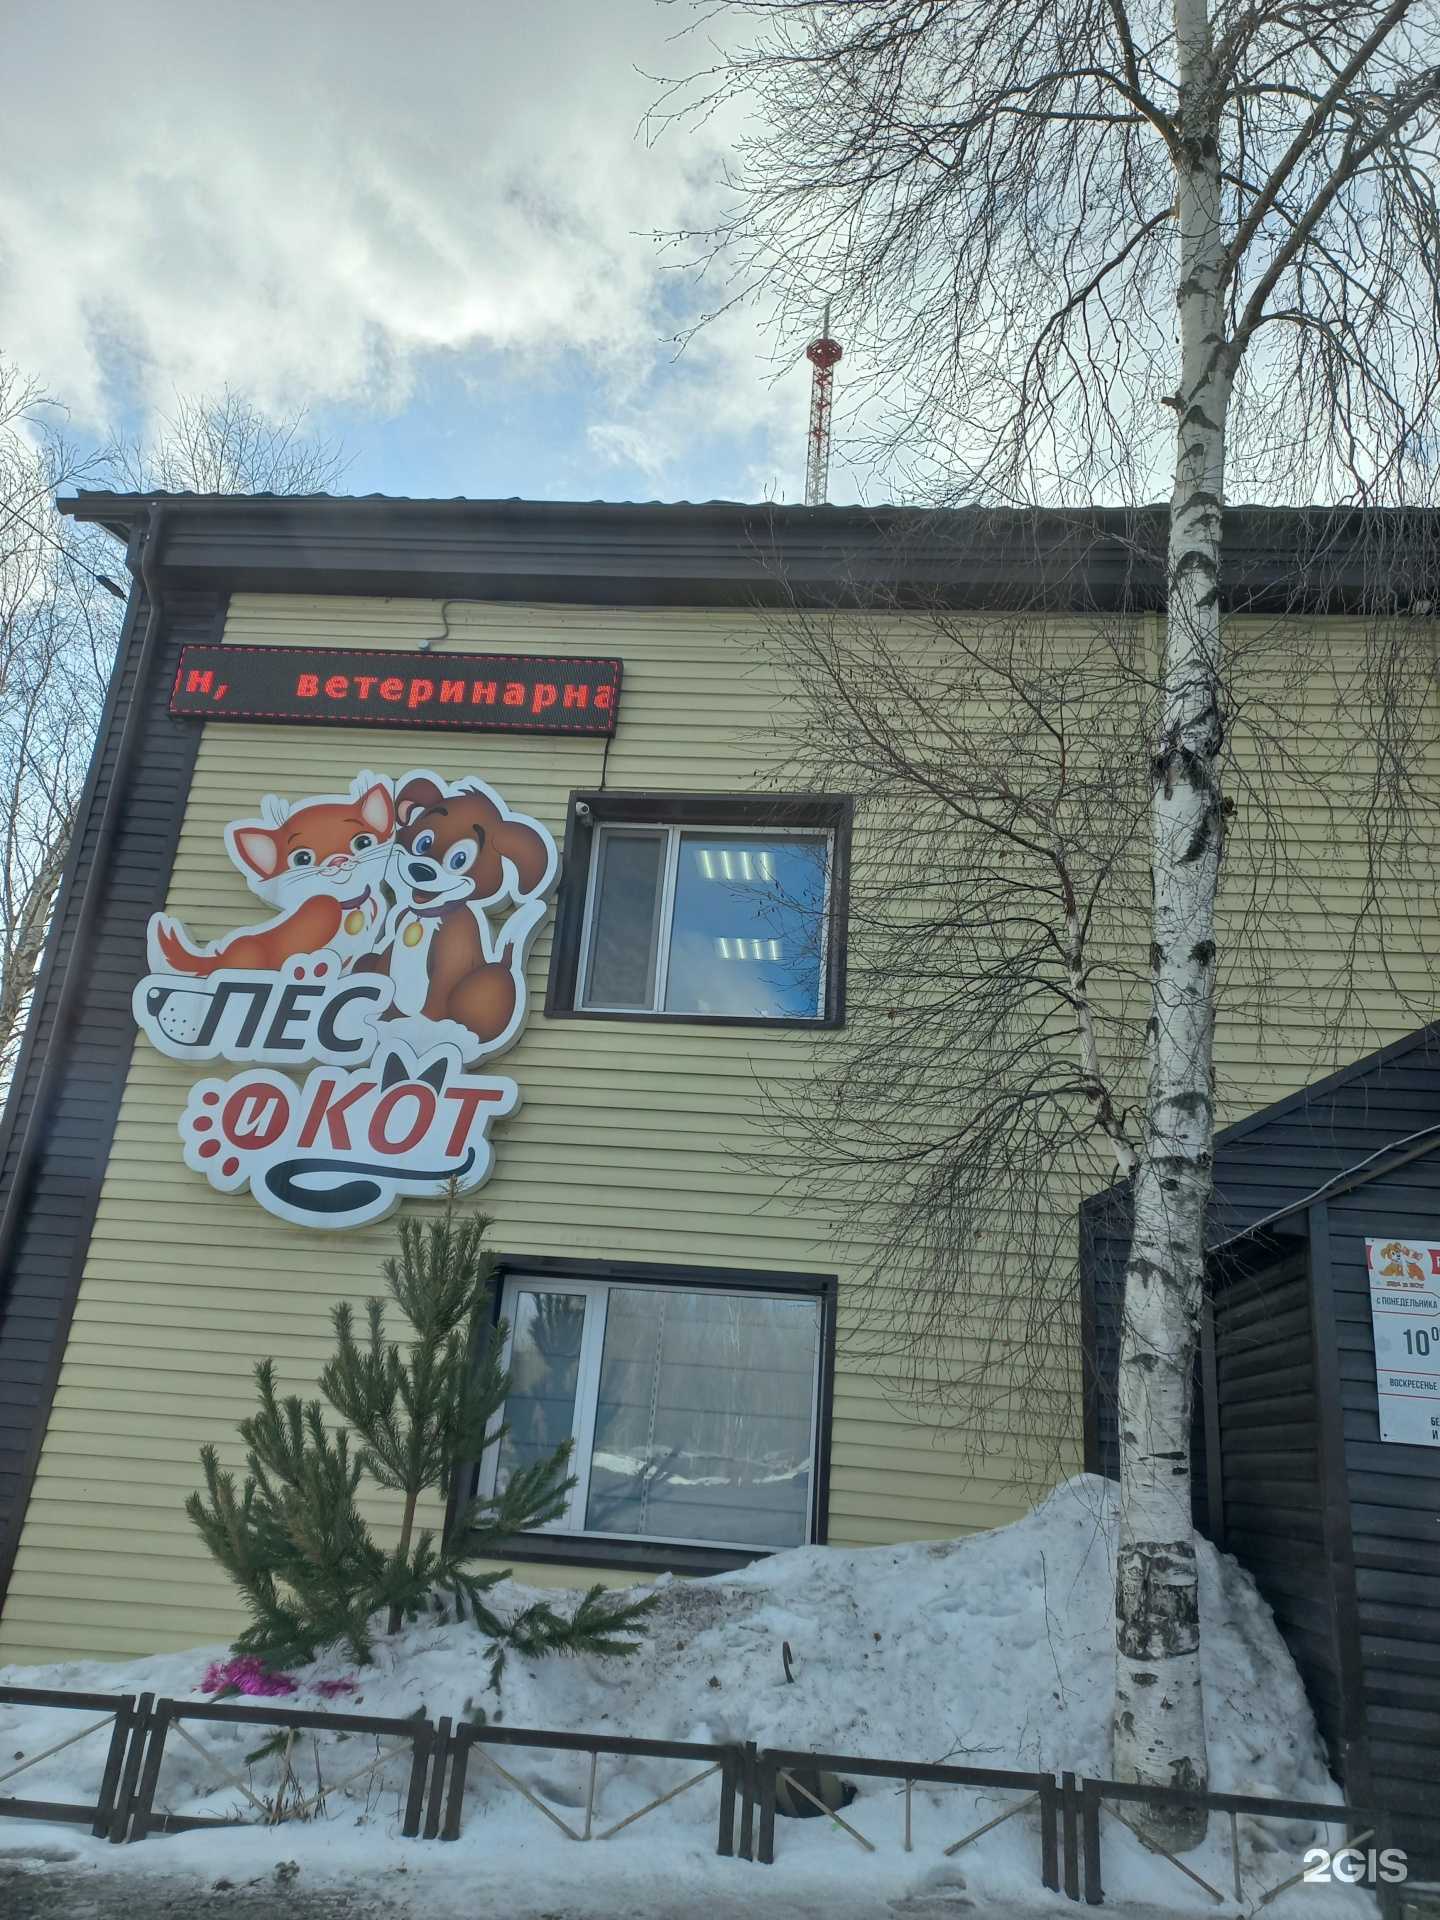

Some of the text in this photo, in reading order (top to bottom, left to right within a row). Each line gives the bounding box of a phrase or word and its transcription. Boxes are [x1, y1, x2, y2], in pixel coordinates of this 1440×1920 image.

[296, 673, 611, 714] ветеринарна
[193, 962, 380, 1052] ПЁС
[297, 1079, 504, 1157] КОТ
[1382, 1297, 1438, 1309] ПОНЕДЕЛЬНИКА
[1390, 1378, 1438, 1391] ВОСКРЕСЕНЬЕ
